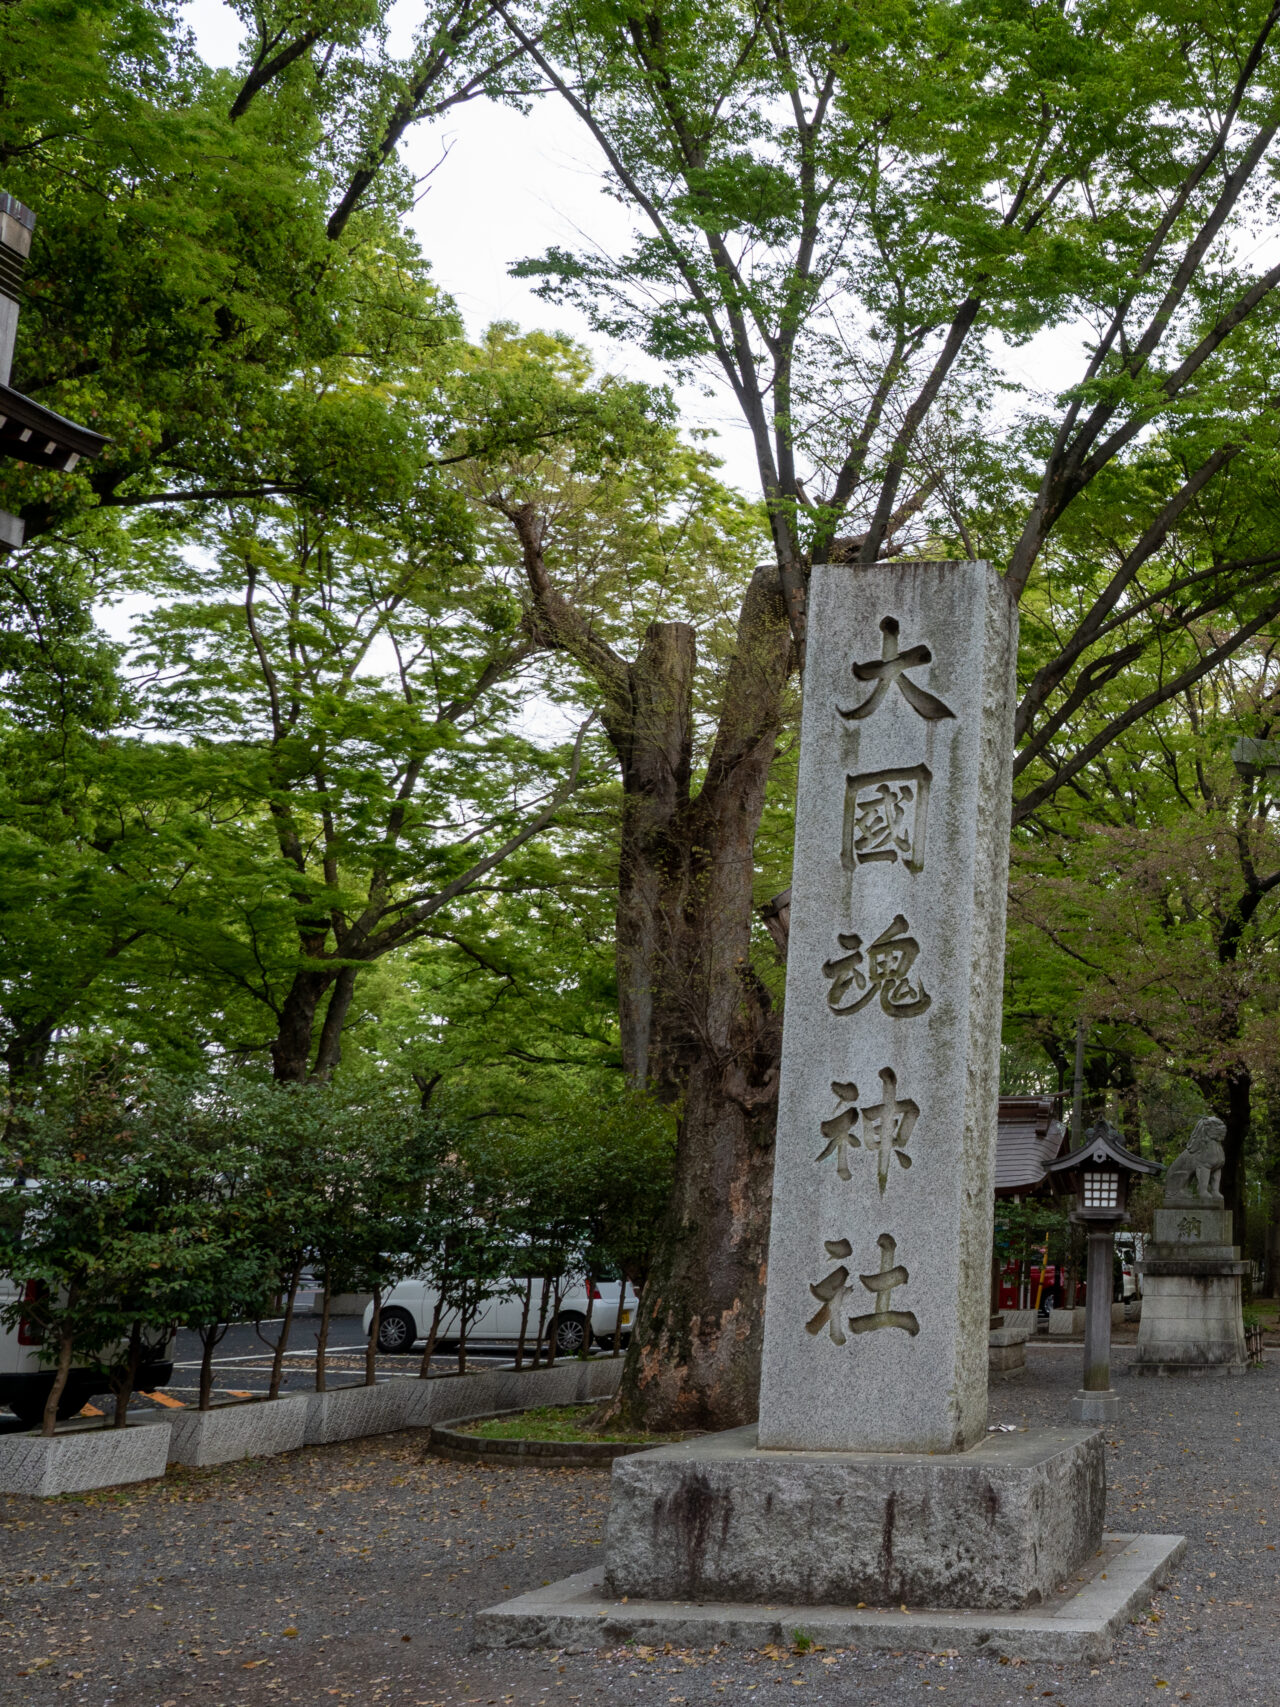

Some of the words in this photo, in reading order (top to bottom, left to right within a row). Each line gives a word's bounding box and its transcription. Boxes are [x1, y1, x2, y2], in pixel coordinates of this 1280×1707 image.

[805, 615, 956, 1346] 大國魂神社
[1177, 1216, 1202, 1238] 納
